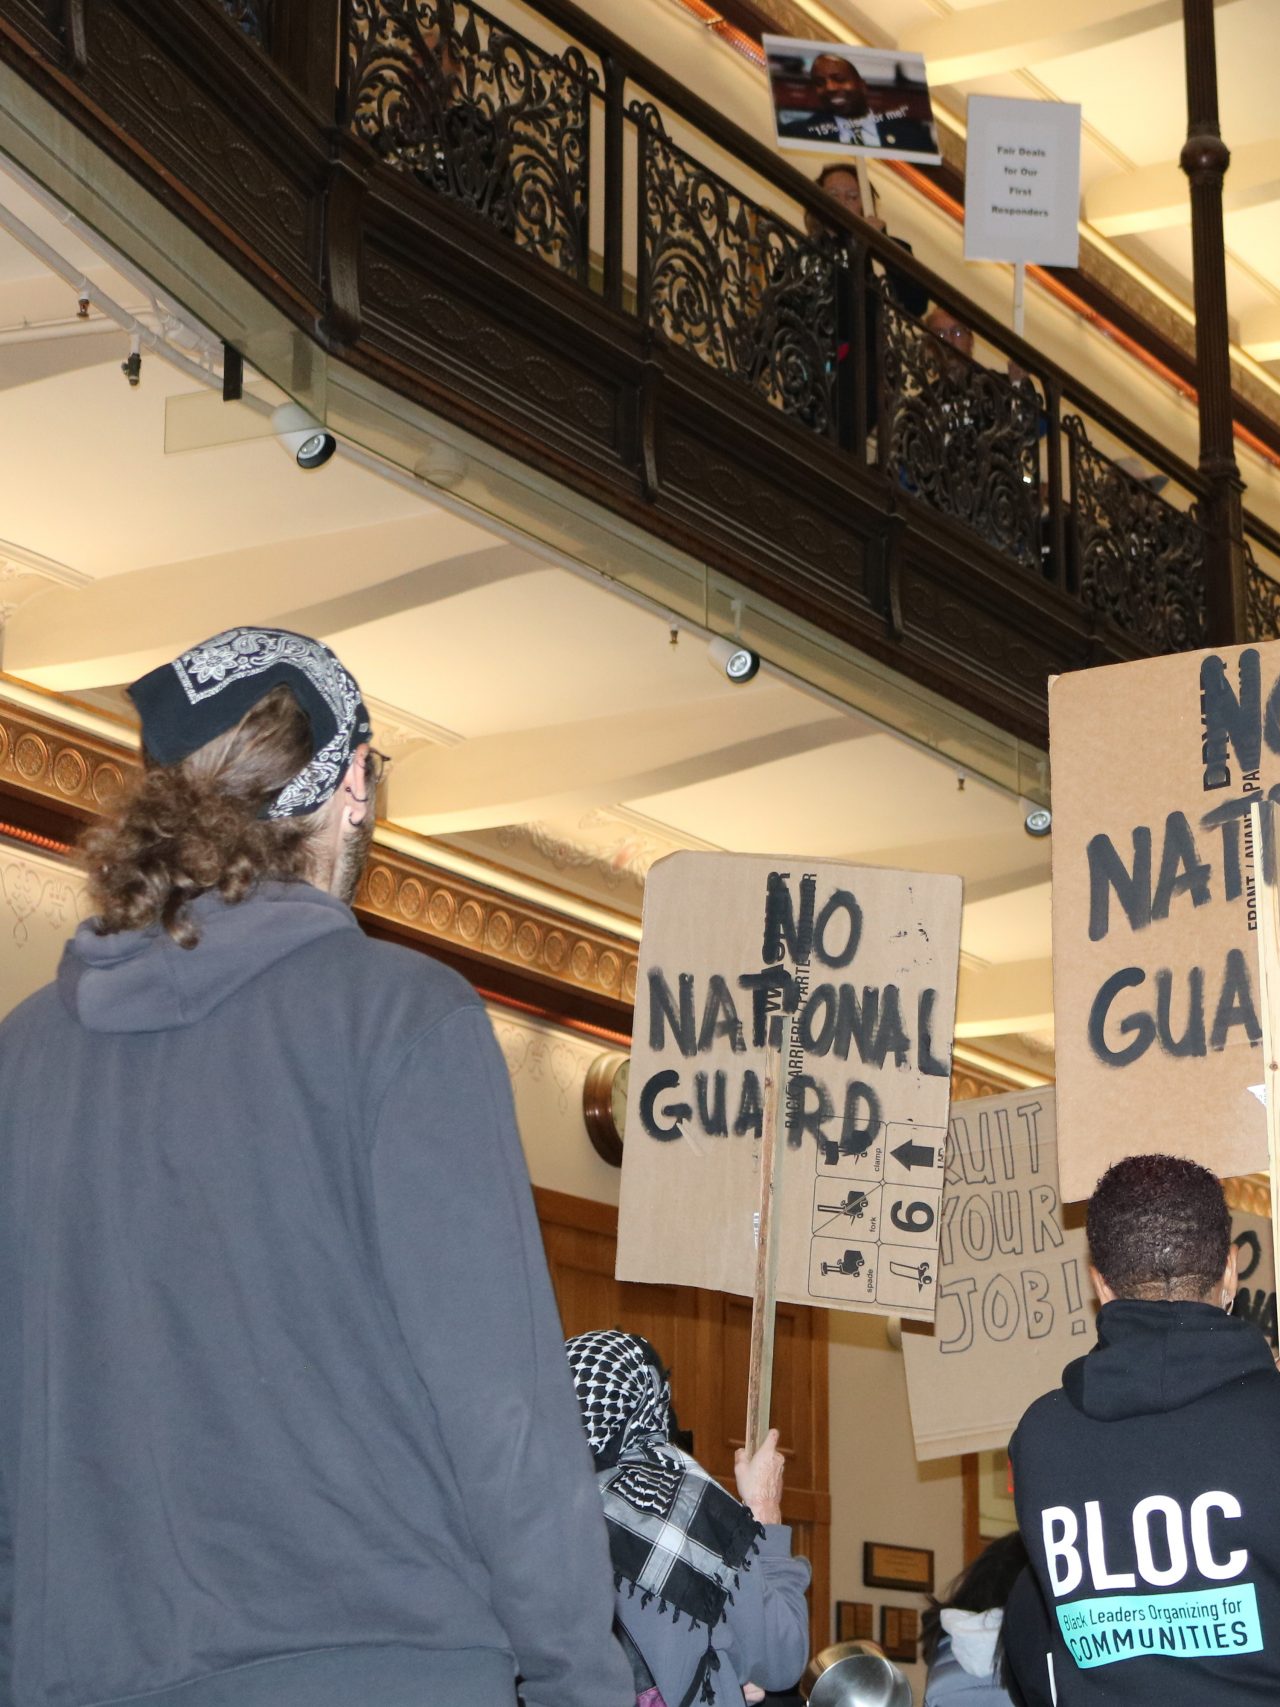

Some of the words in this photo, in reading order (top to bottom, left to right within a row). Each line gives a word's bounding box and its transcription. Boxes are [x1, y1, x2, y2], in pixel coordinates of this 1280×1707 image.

[997, 146, 1016, 155] Fair
[1018, 147, 1046, 157] Deals
[1004, 166, 1017, 175] for
[1020, 167, 1038, 176] Our
[1009, 187, 1032, 197] First
[991, 205, 1049, 218] Responders
[762, 871, 864, 969] NO
[647, 965, 950, 1077] NATIONAL
[639, 1068, 883, 1157] GUARD
[873, 1147, 881, 1172] clamp
[890, 1200, 935, 1233] 6
[940, 1184, 1064, 1266] YOUR
[866, 1268, 874, 1293] spade
[939, 1258, 1087, 1354] JOB!
[1041, 1490, 1249, 1598] BLOC
[1063, 1613, 1088, 1631] Black
[1089, 1607, 1146, 1626] Leaders
[1149, 1601, 1219, 1624] Organizing
[1222, 1598, 1242, 1615] for
[1069, 1620, 1249, 1663] COMMUNITIES
